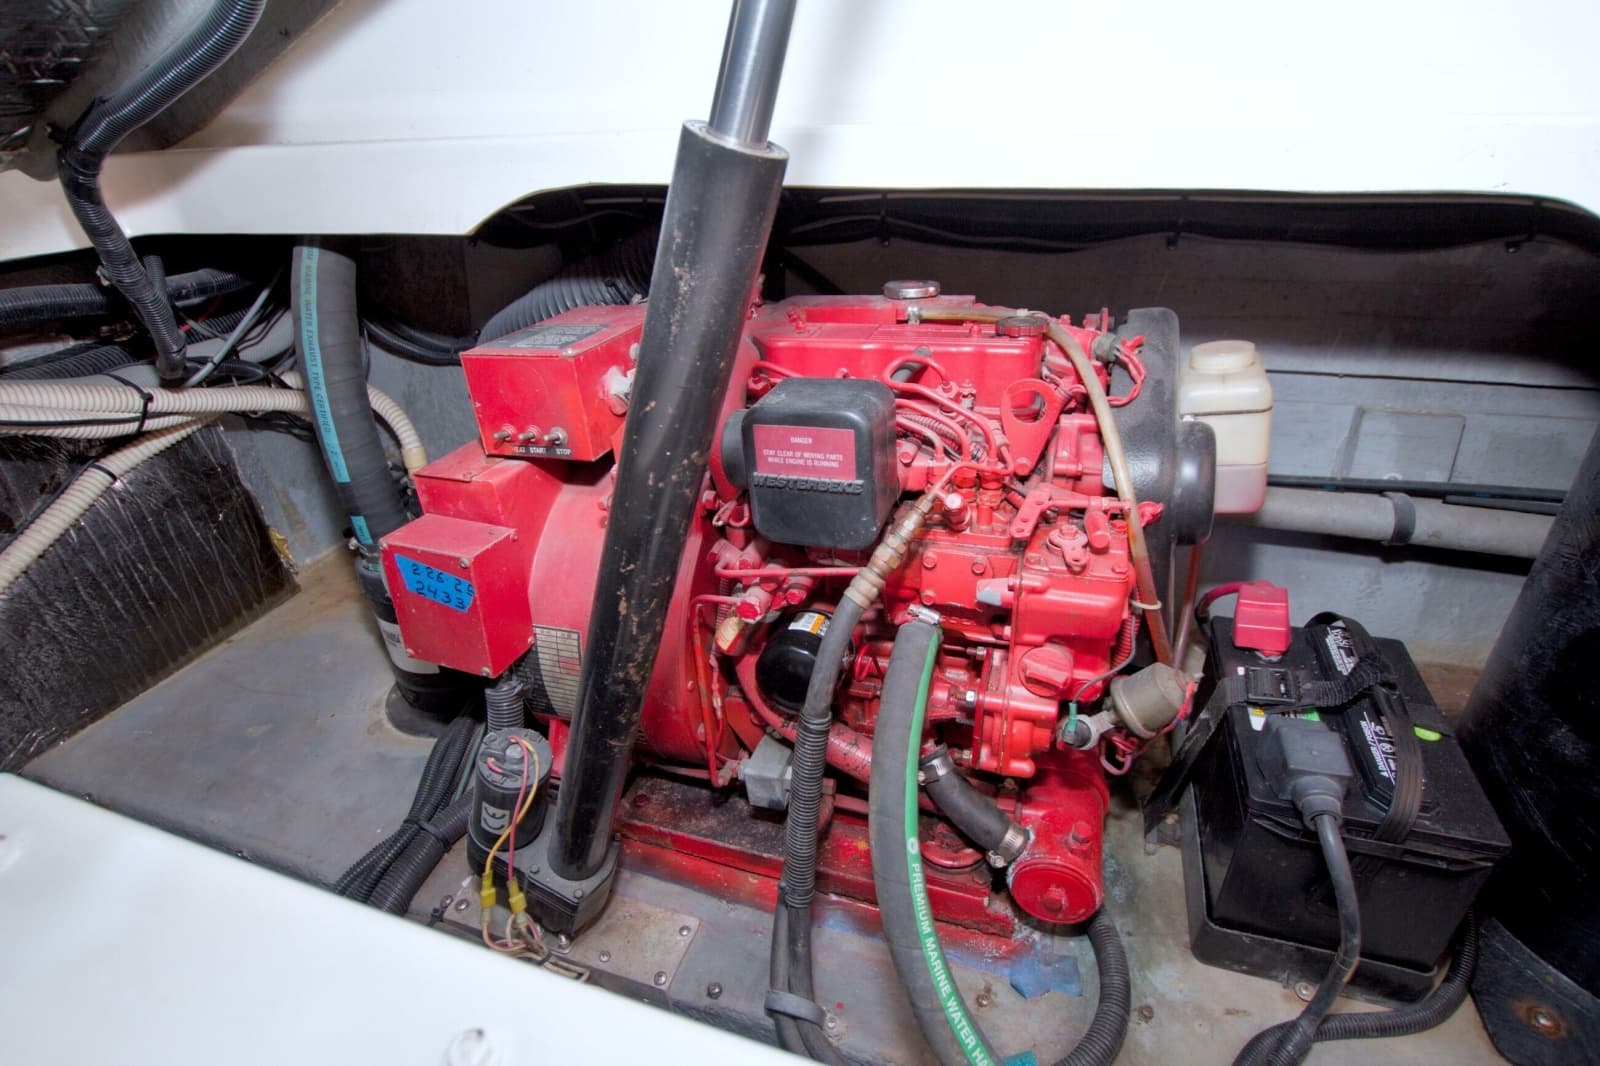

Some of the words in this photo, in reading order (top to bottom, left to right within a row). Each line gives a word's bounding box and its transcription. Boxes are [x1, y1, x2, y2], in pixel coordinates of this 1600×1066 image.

[305, 328, 318, 368] EXHAUST
[311, 371, 321, 390] TYPE
[316, 392, 331, 433] CERTIFIED
[790, 436, 812, 445] DANGER
[556, 448, 572, 456] STOP
[777, 450, 794, 458] CLEAR
[804, 452, 825, 460] MOVING
[826, 454, 843, 462] PARTS
[785, 458, 805, 466] ENGINE
[753, 472, 864, 495] WESTERBEKE
[416, 581, 465, 610] 2433
[912, 863, 931, 934] PREMIUM
[925, 938, 951, 996] MARINE
[946, 996, 977, 1050] WATER
